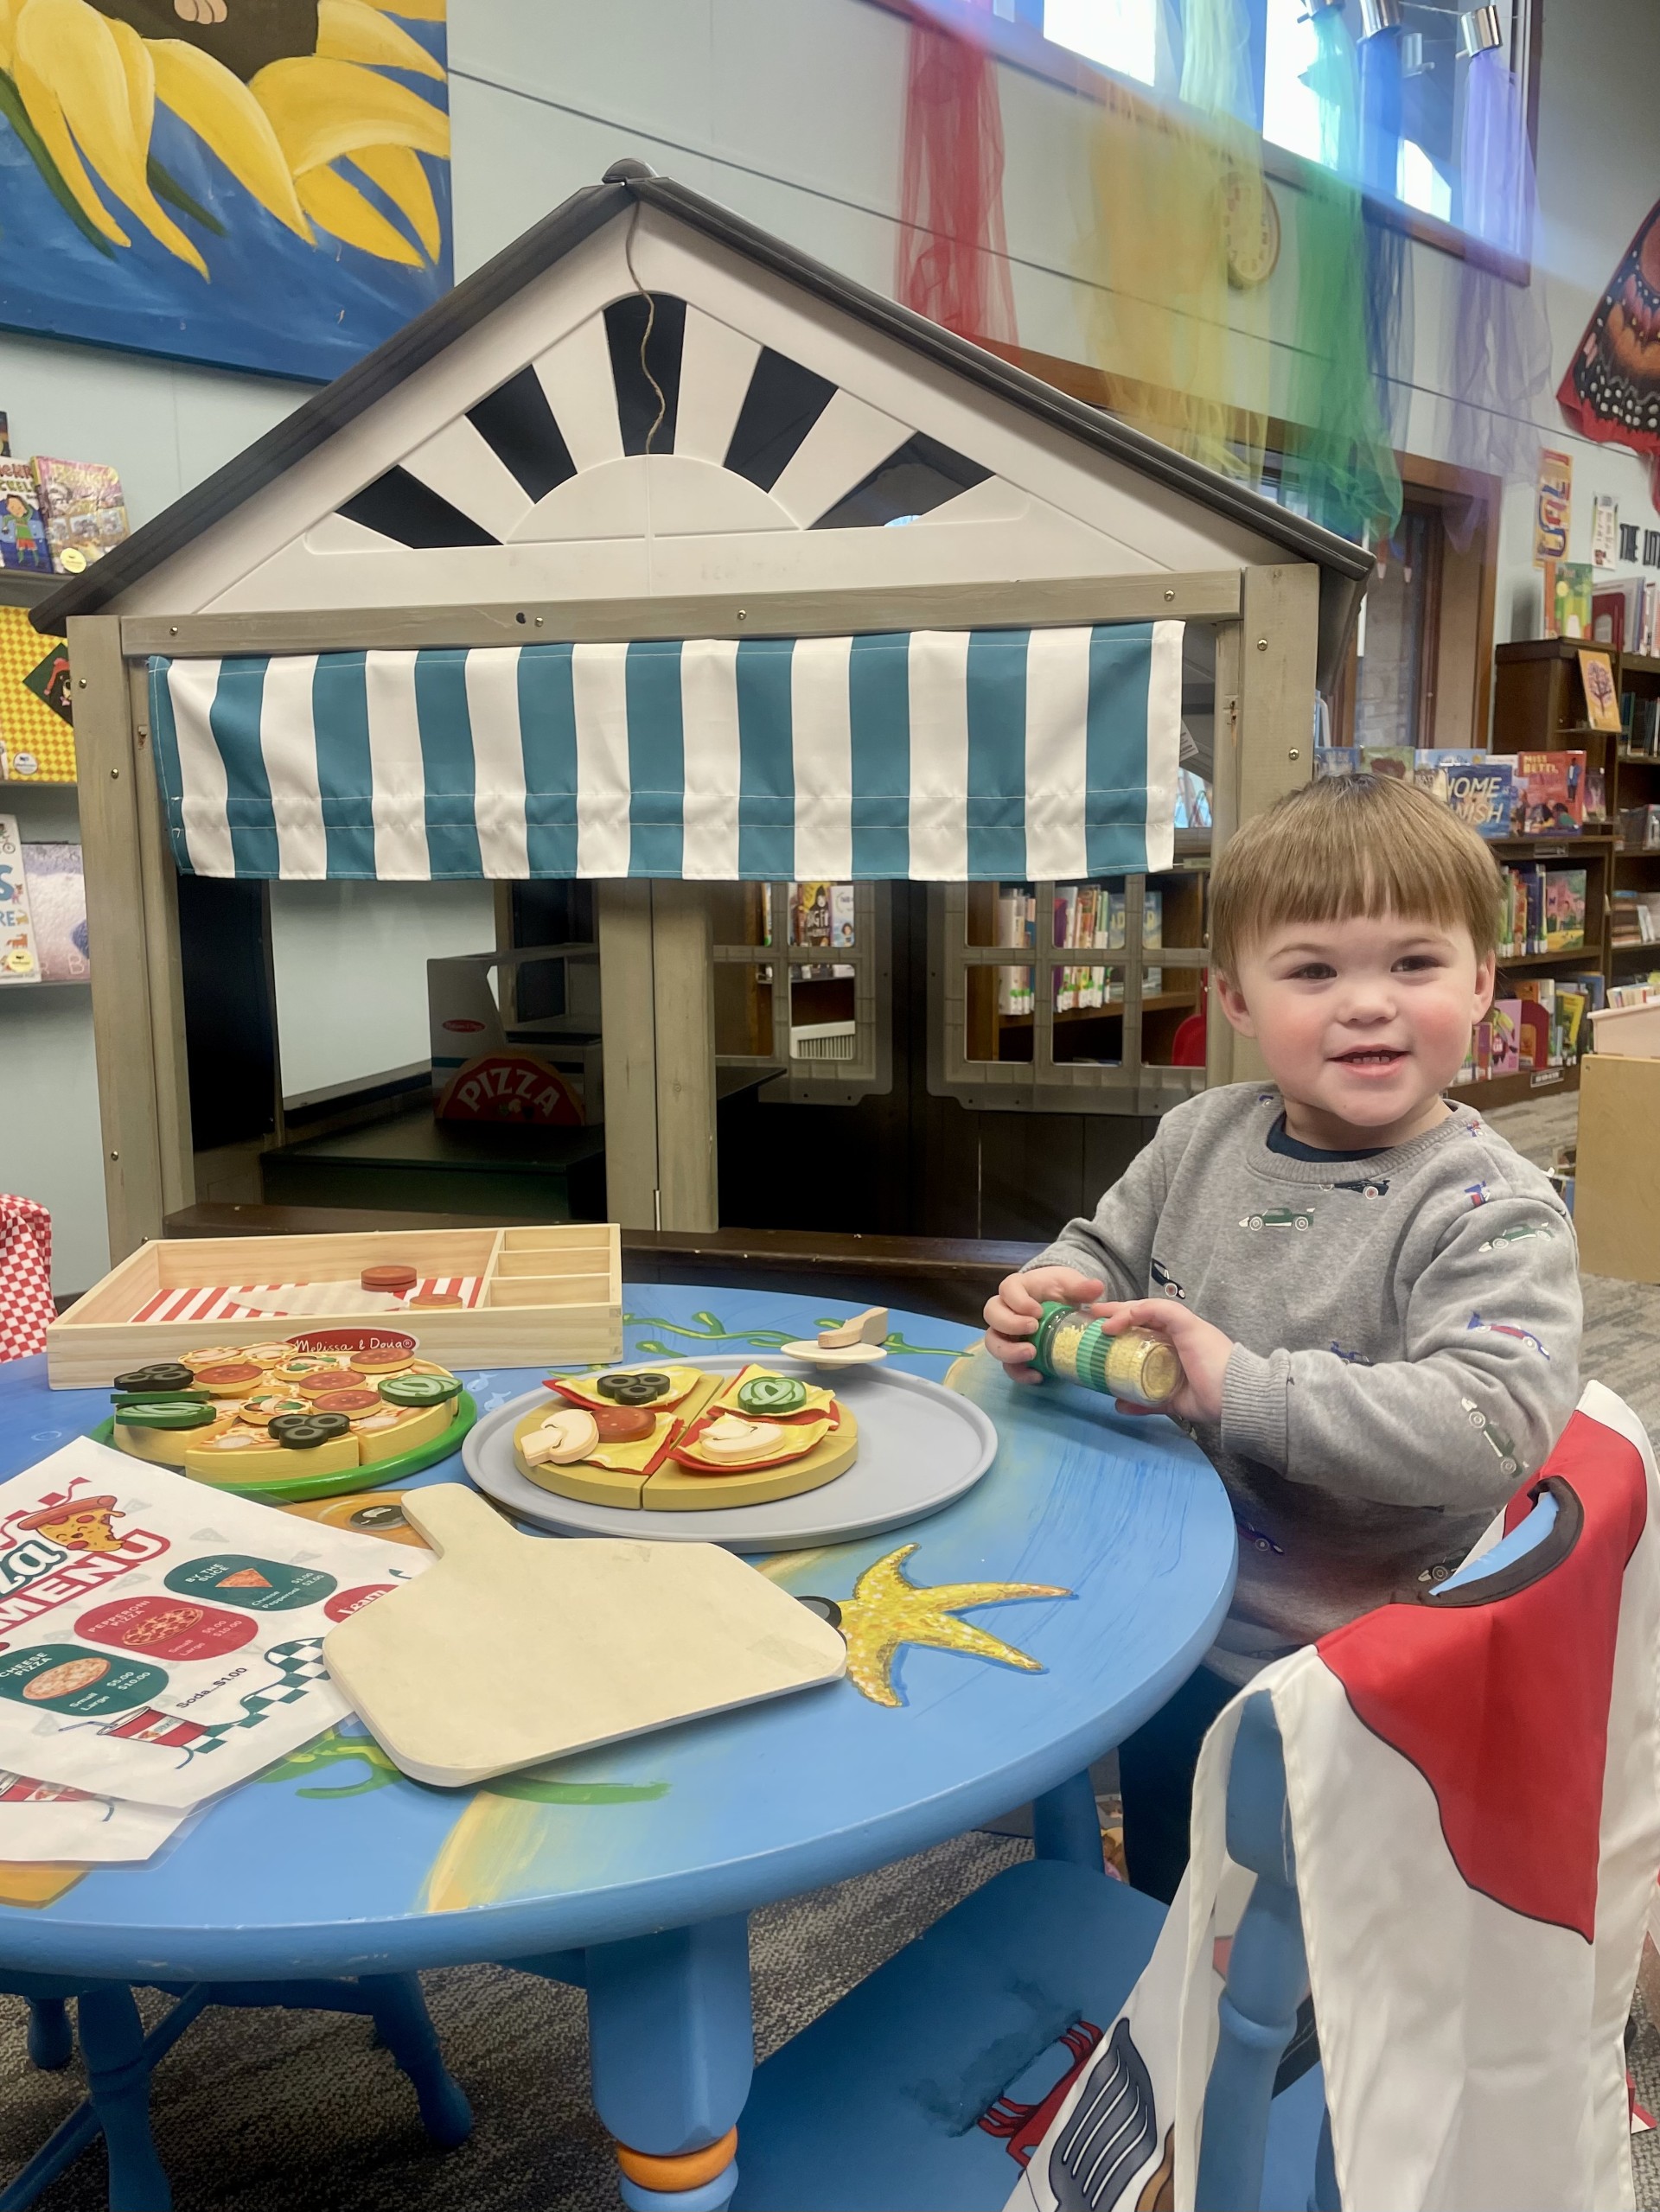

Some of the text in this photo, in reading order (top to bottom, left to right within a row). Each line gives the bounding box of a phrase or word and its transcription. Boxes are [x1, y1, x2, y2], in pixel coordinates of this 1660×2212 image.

[457, 1067, 560, 1117] PIZZA
[359, 1339, 366, 1350] &
[0, 1529, 169, 1634] MENU
[185, 1563, 225, 1584] BY THE
[198, 1565, 230, 1583] SLICE
[261, 1587, 301, 1609] Pepperoni
[87, 1599, 151, 1633] PEPPERONI
[112, 1610, 146, 1628] PIZZA
[168, 1639, 195, 1654] Small
[0, 1652, 48, 1679] CHEESE
[14, 1657, 54, 1677] PIZZA
[68, 1671, 135, 1709] Small $5.00
[117, 1671, 151, 1691] $10.00
